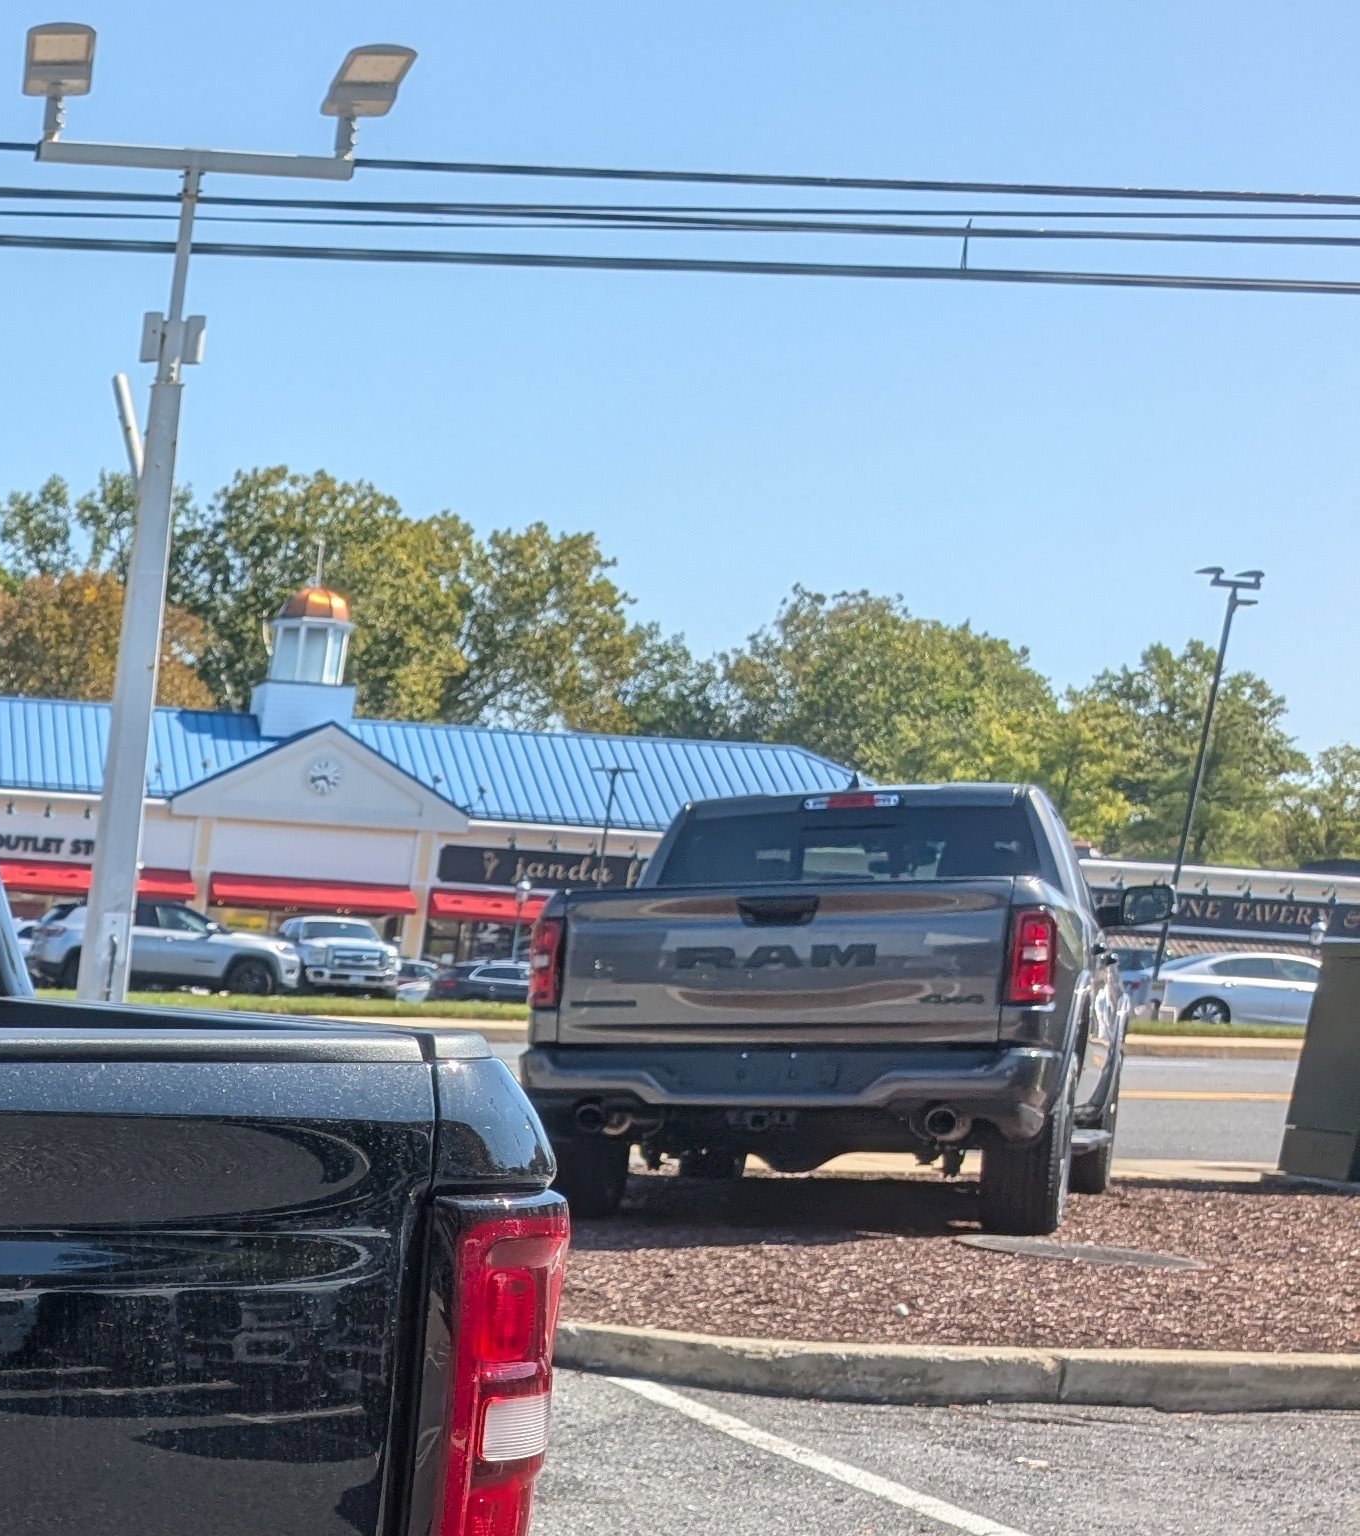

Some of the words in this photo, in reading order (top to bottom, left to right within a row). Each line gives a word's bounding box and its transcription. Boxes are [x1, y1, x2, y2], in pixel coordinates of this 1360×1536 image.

[68, 838, 95, 856] ST
[511, 857, 614, 884] janda
[676, 943, 877, 970] RAM
